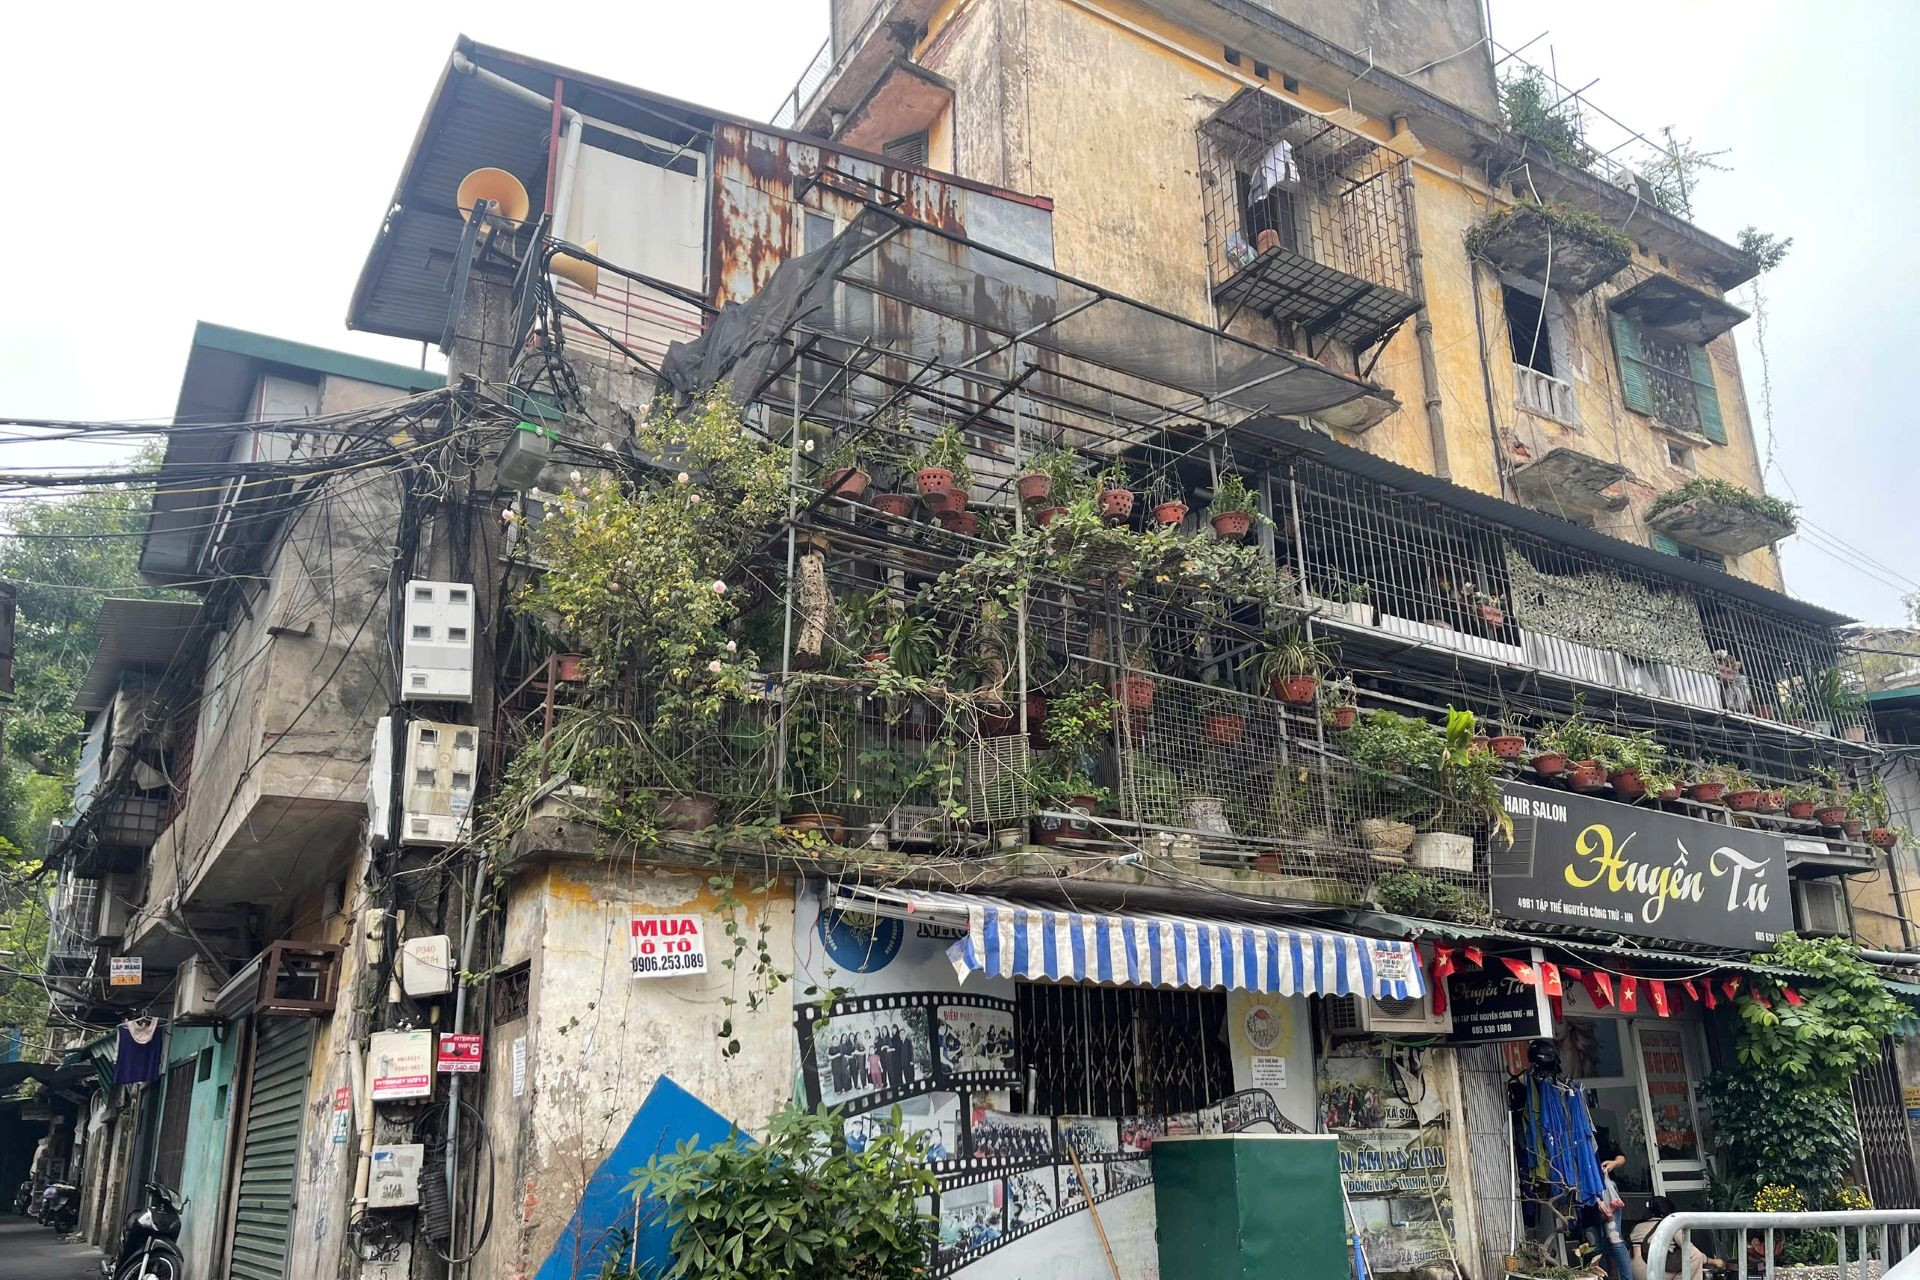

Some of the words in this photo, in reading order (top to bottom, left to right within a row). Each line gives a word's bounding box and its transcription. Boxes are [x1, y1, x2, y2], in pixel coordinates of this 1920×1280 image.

[1504, 795, 1530, 815] HAIR
[1533, 801, 1567, 822] SALON
[1564, 824, 1704, 923] Huyền
[1709, 846, 1771, 912] Tú
[1518, 897, 1534, 909] 49B1
[1536, 898, 1548, 912] TẬP
[1563, 902, 1589, 917] NGUYỄN
[1590, 906, 1607, 919] CÔNG
[1625, 912, 1634, 922] HN
[631, 919, 698, 936] MUA
[641, 939, 655, 954] Ô
[663, 938, 692, 953] TÔ
[632, 953, 704, 973] 0906.253.089
[470, 1042, 480, 1056] 6
